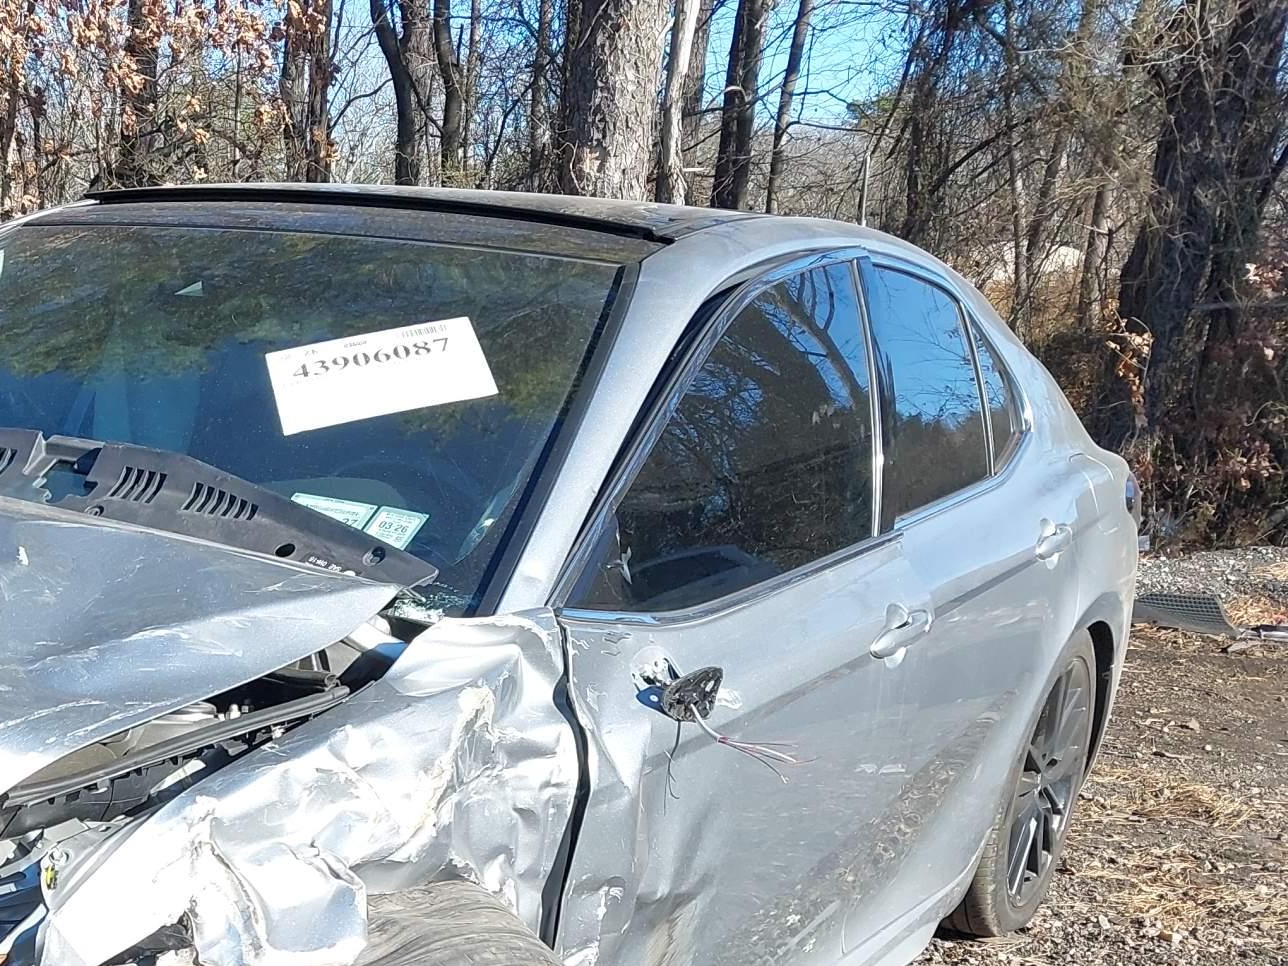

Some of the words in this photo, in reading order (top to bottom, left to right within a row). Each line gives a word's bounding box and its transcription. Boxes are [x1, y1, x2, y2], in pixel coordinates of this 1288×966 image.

[292, 338, 449, 377] 43906087
[378, 520, 393, 530] 03
[394, 524, 409, 534] 26
